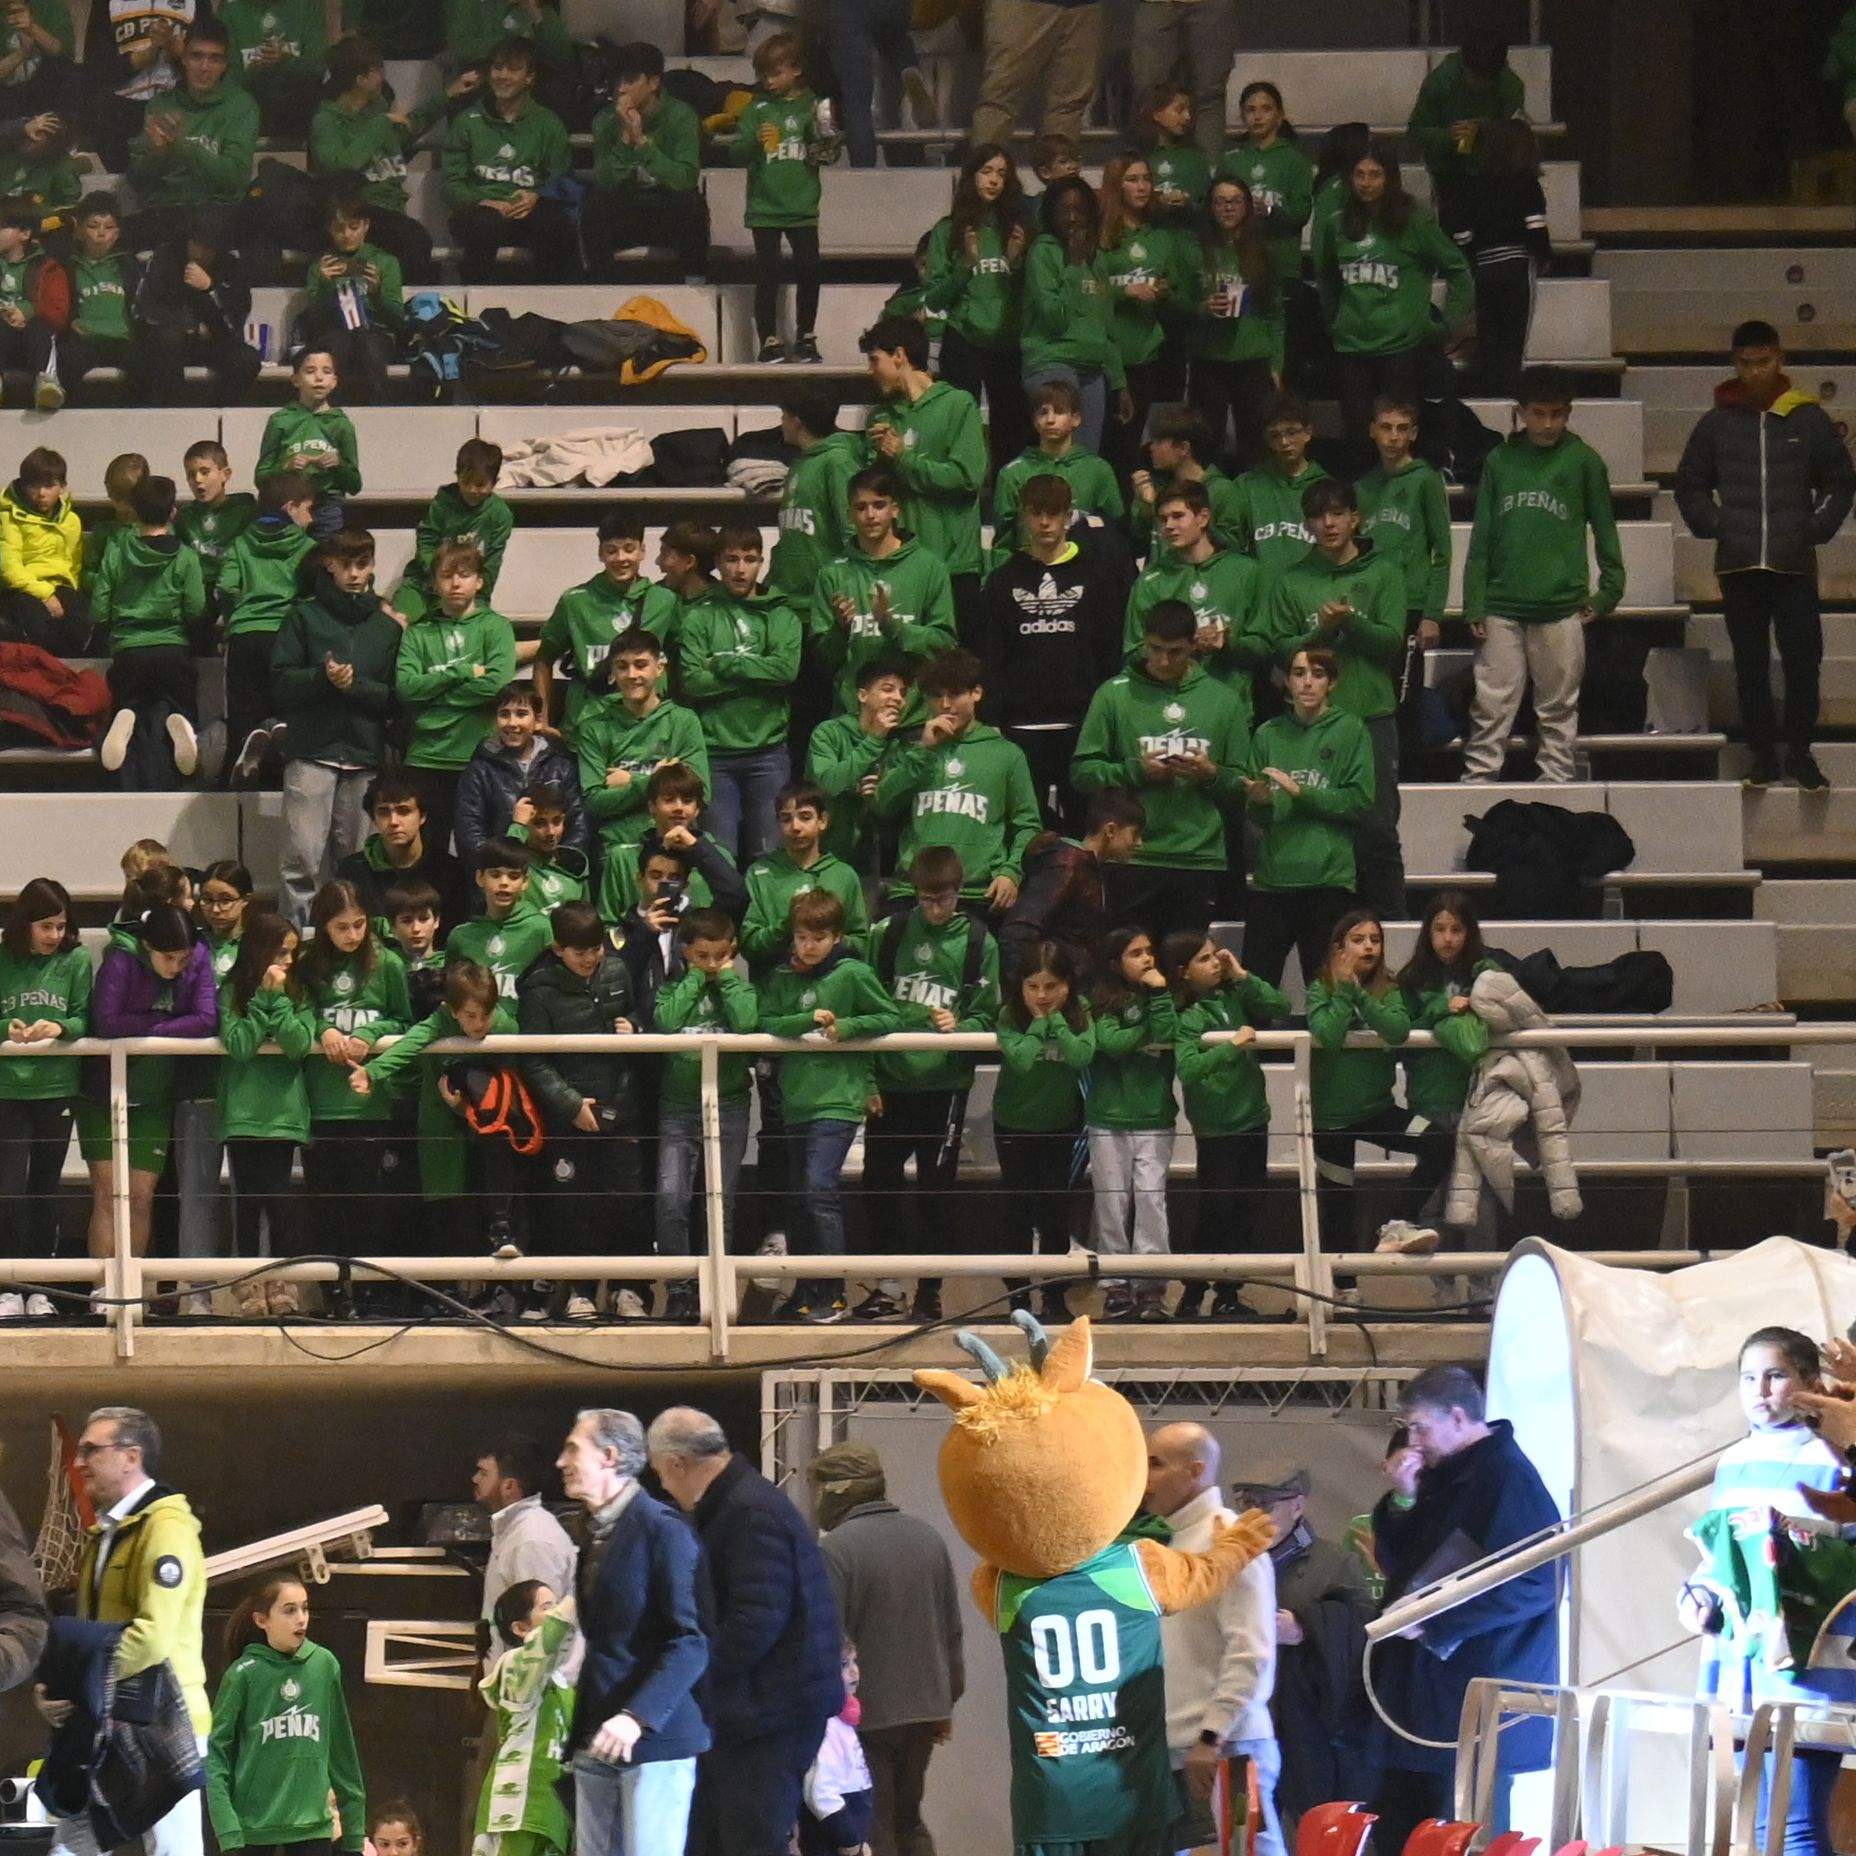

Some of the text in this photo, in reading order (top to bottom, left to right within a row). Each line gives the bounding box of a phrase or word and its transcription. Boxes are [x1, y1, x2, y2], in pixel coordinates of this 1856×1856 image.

[1019, 619, 1076, 635] adidas
[1030, 1608, 1120, 1689] 00
[1045, 1692, 1118, 1724] SARRY
[1059, 1725, 1127, 1744] GOBIERNO
[1060, 1743, 1080, 1756] DE
